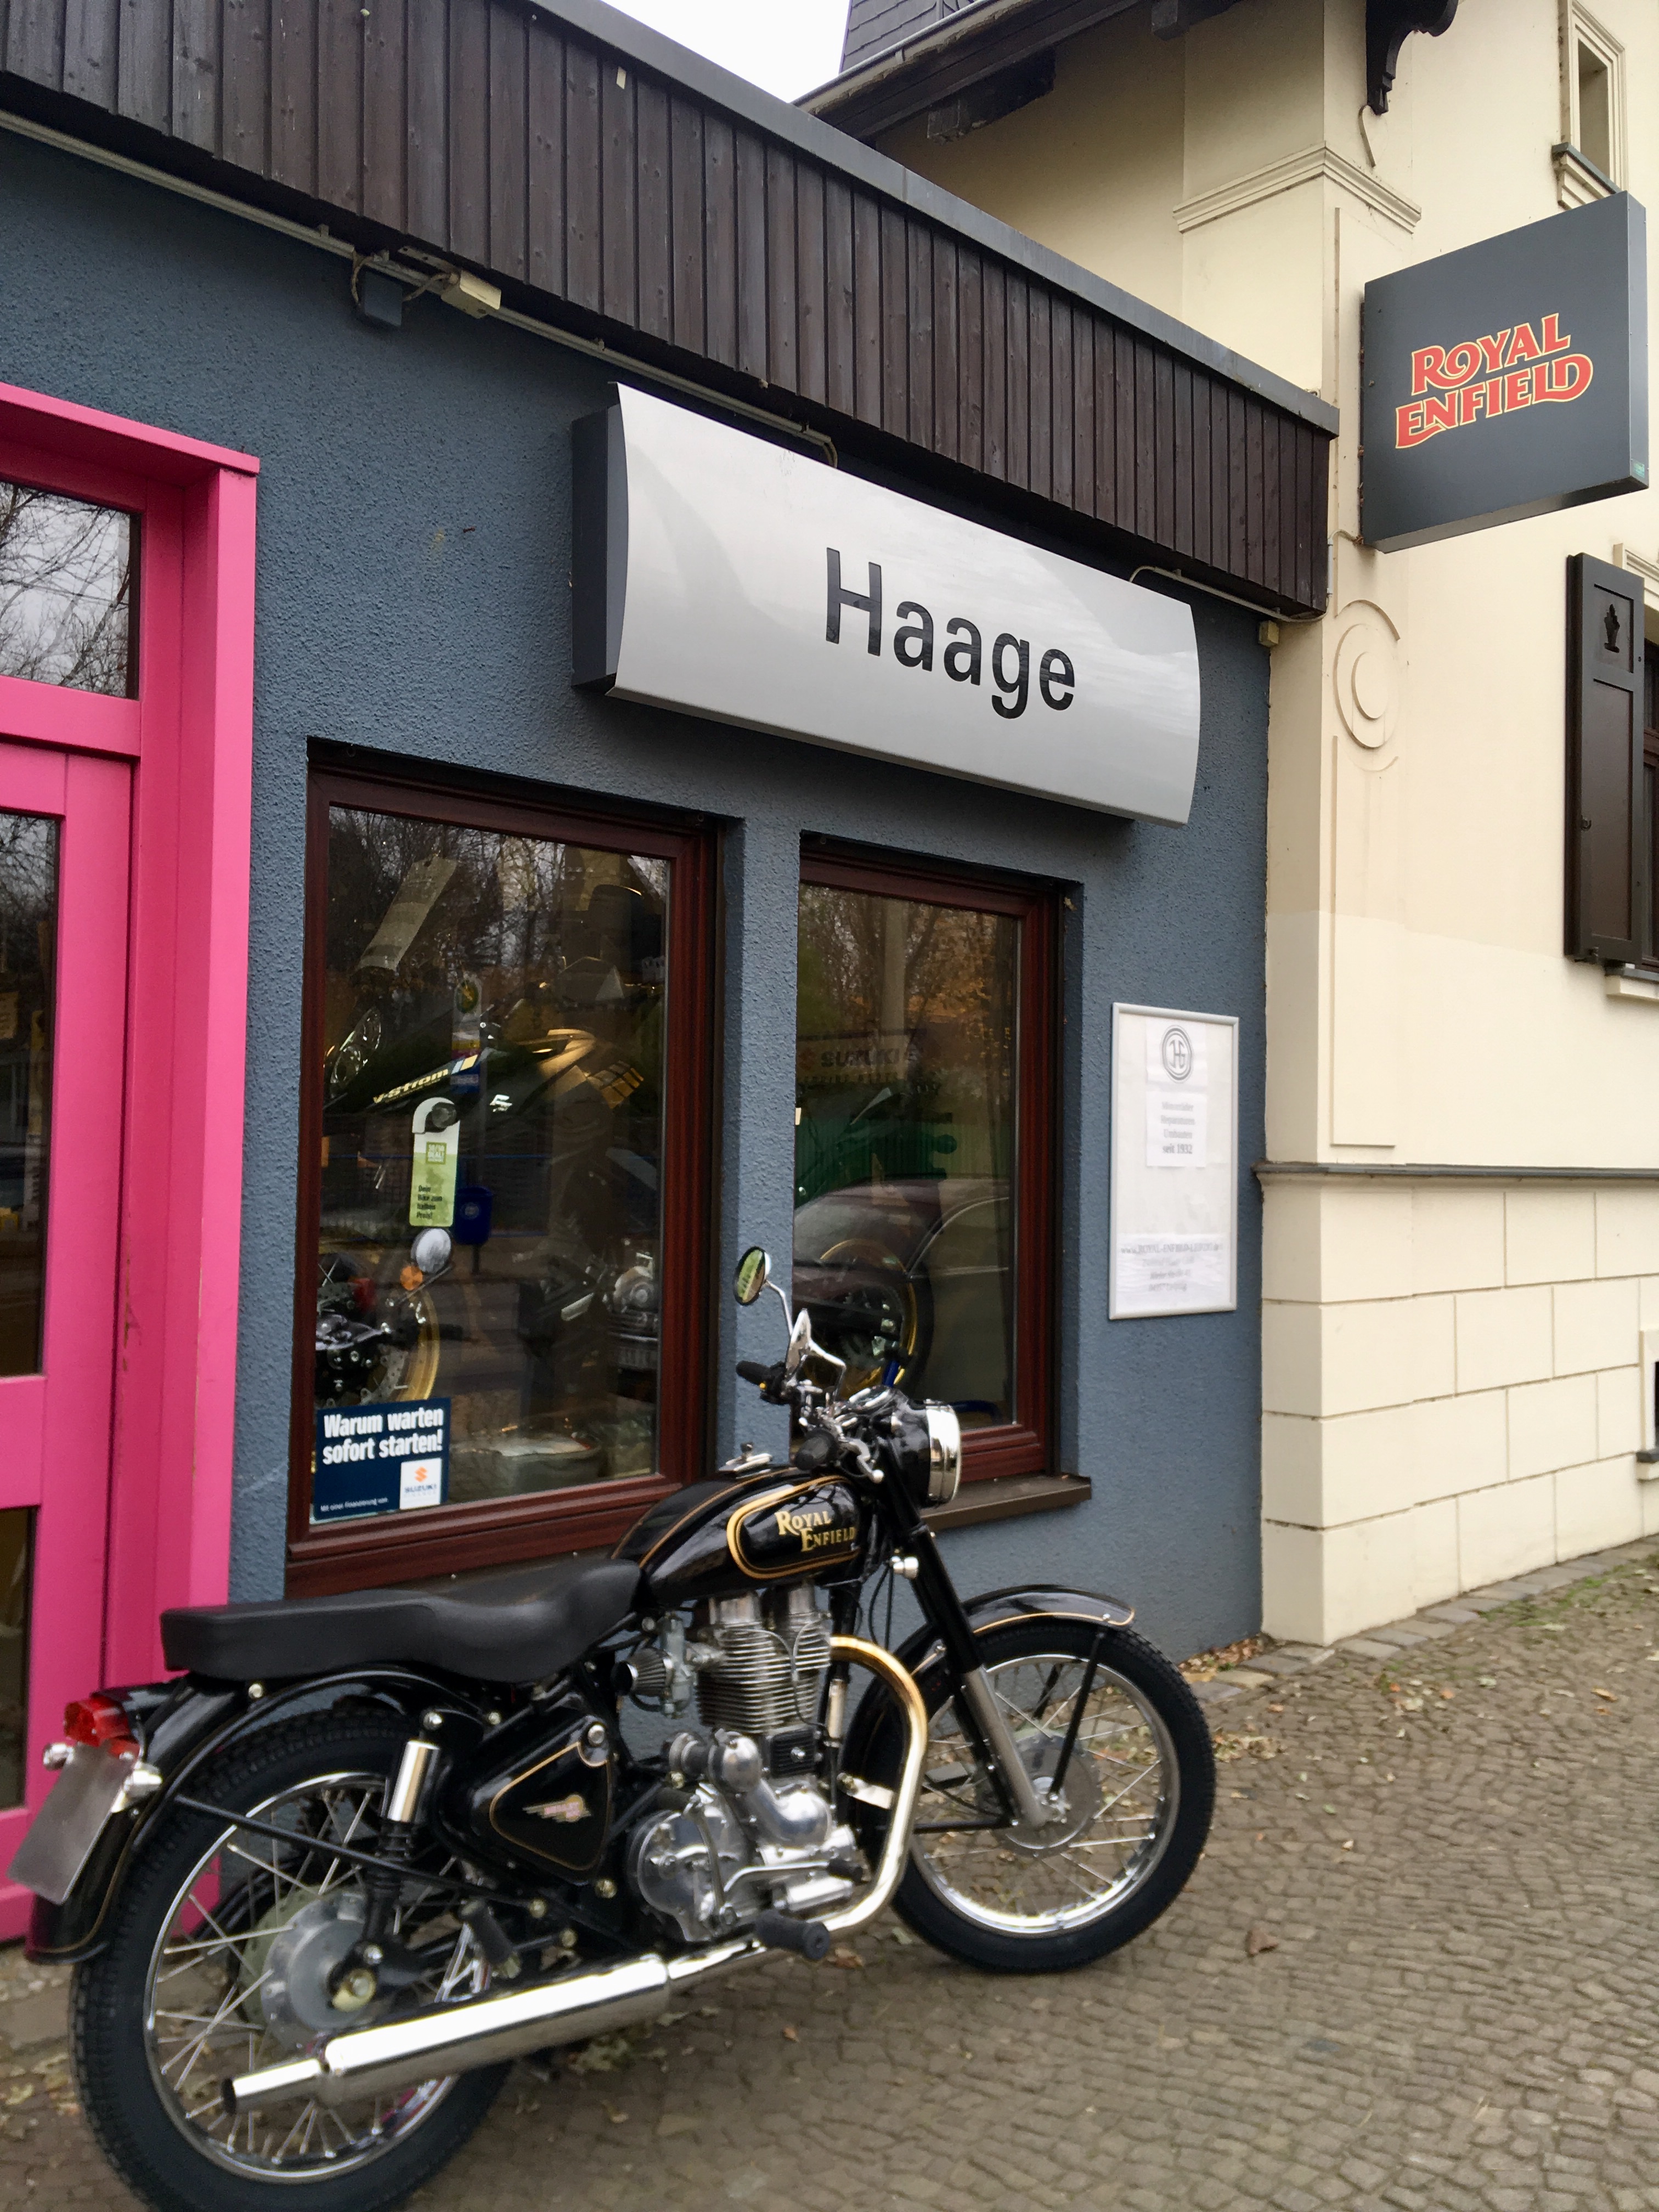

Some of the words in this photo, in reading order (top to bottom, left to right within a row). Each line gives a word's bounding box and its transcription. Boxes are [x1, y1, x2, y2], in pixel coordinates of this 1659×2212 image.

[1412, 313, 1571, 396] ROYAL
[1395, 354, 1594, 449] ENFIELD
[826, 547, 1075, 719] Haage
[323, 1438, 375, 1465] sofort
[379, 1429, 443, 1458] starten!
[324, 1413, 383, 1438] Warum
[387, 1407, 444, 1431] warten
[405, 1483, 437, 1493] SUZUKI
